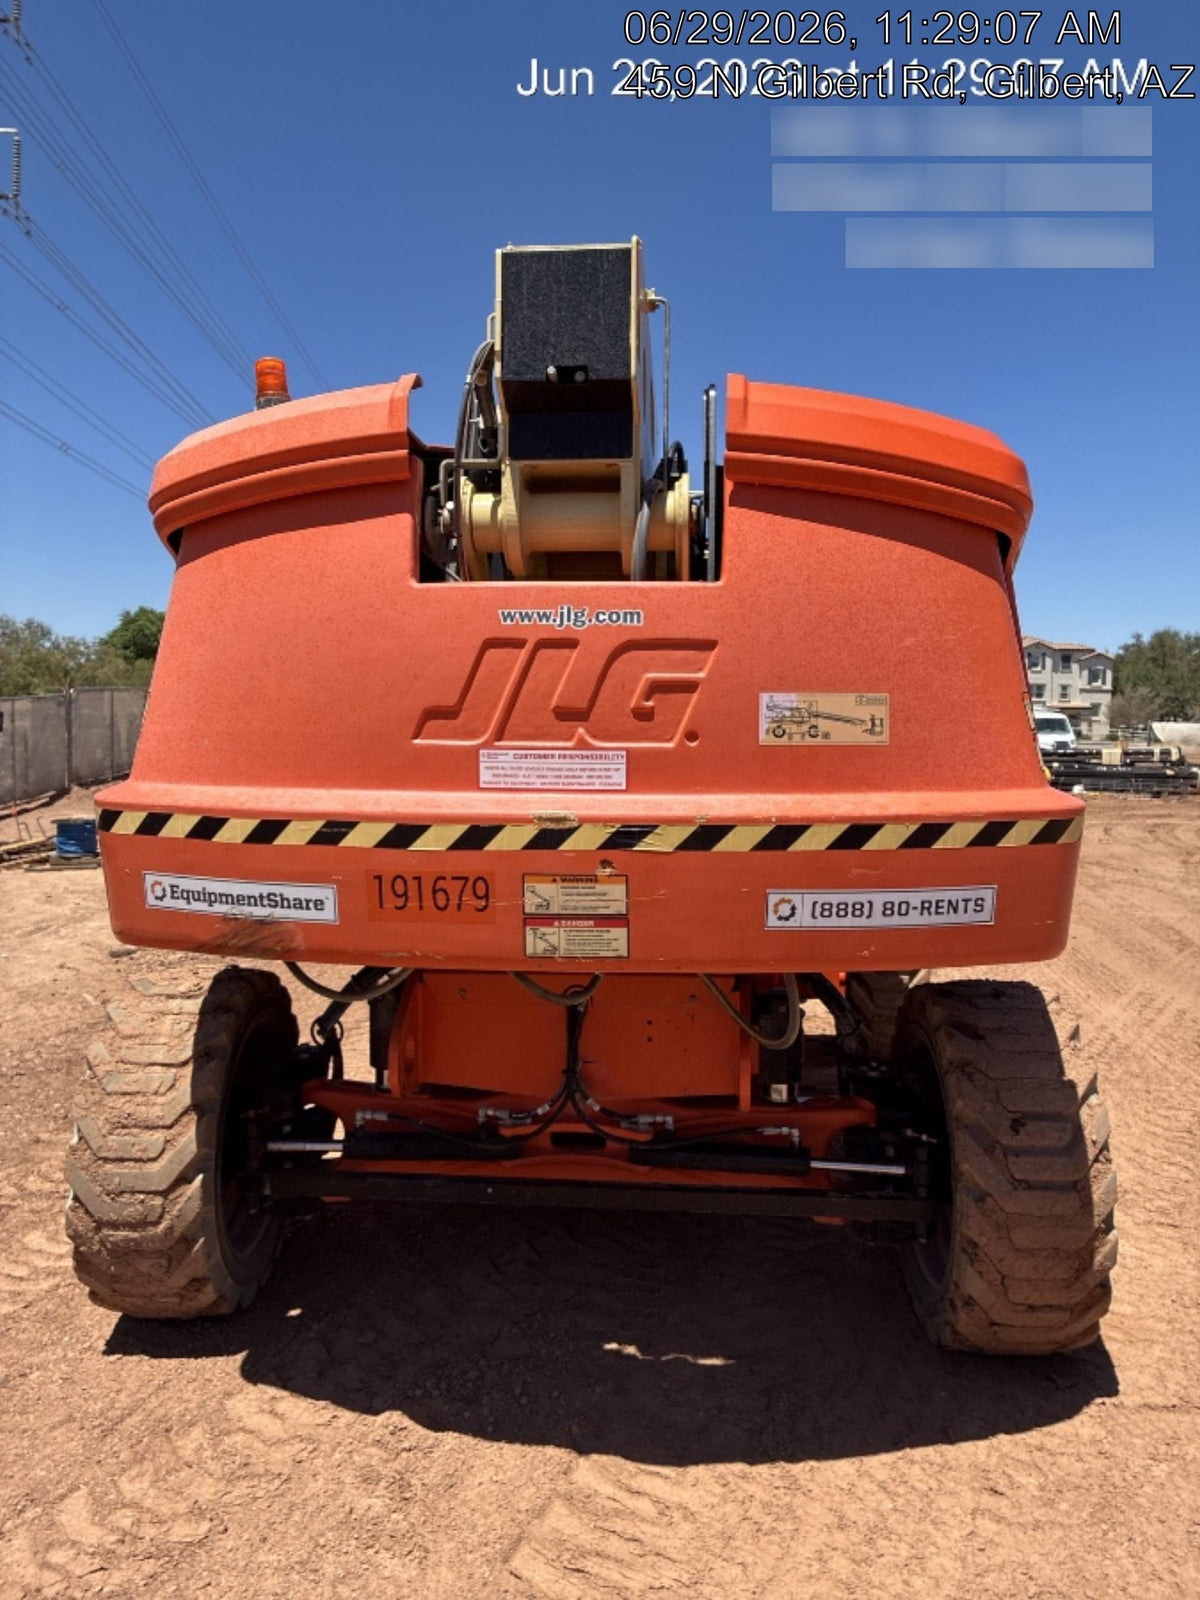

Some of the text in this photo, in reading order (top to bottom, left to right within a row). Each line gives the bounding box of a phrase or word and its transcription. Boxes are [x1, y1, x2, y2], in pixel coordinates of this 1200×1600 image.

[499, 606, 643, 628] www.jlg.com
[169, 884, 326, 912] EquipmentShare
[373, 874, 491, 913] 191679
[811, 897, 986, 919] (888) 80-RENTS
